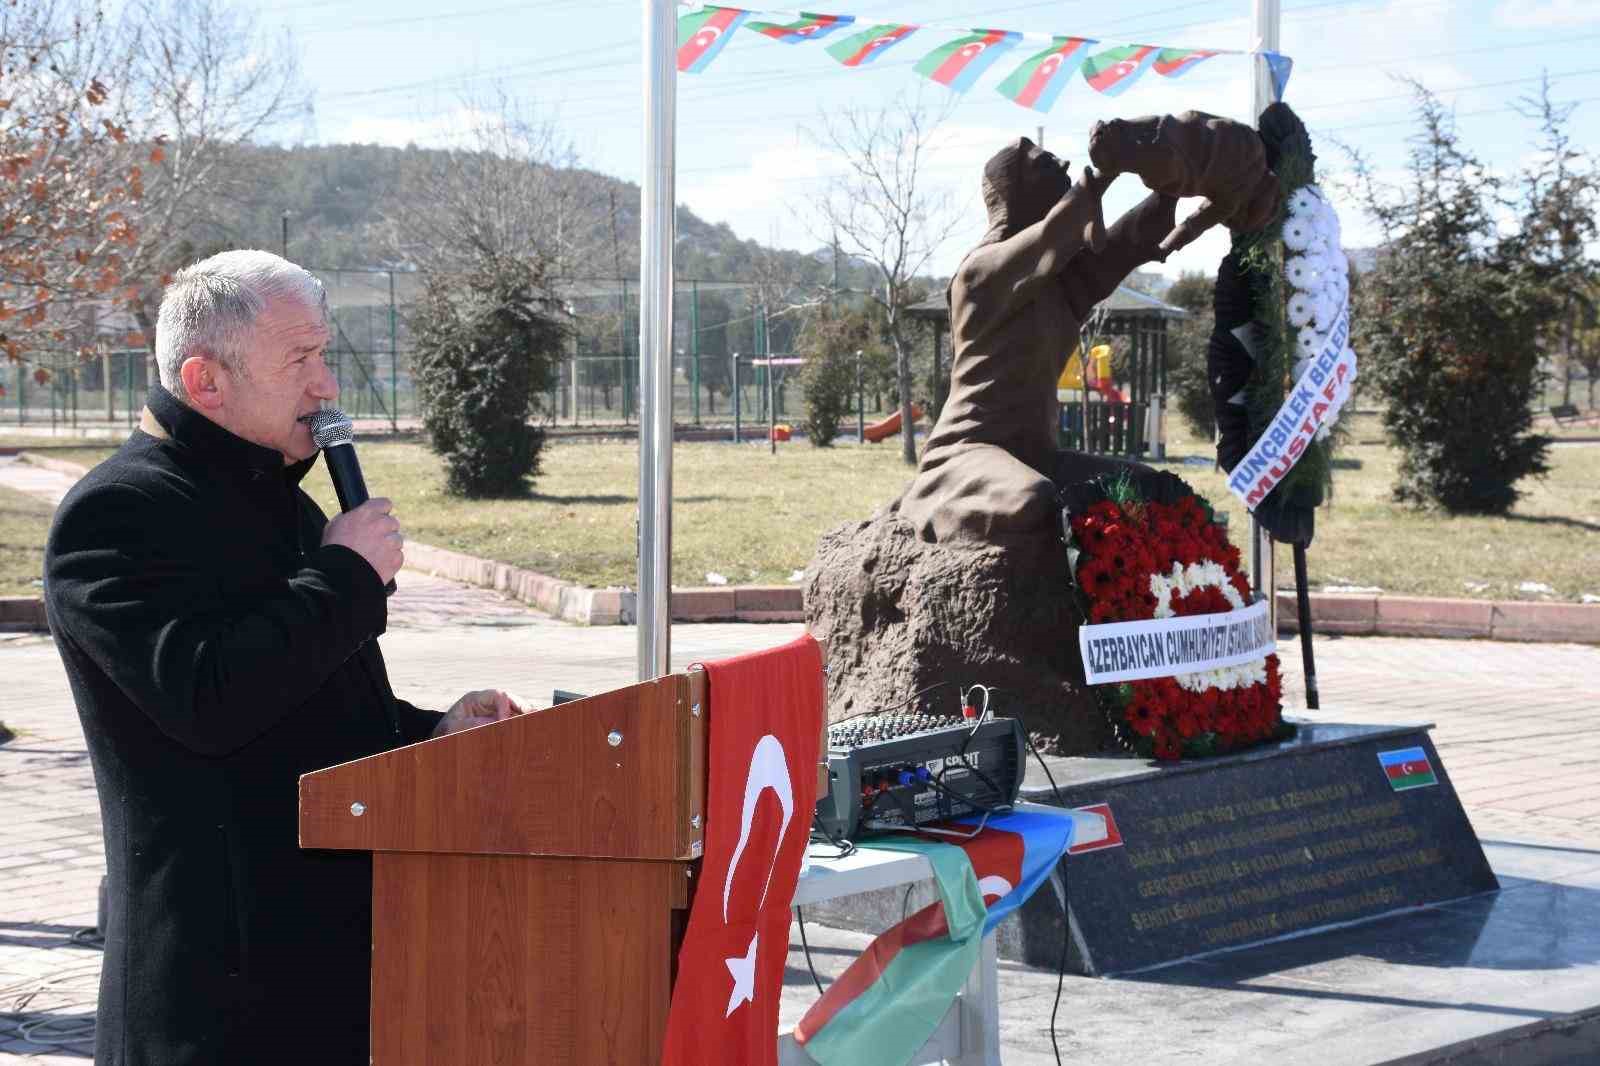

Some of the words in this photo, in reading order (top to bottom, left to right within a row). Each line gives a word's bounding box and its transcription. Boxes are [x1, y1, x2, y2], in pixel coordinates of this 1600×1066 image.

[1309, 318, 1347, 387] BELED
[1246, 362, 1347, 506] MUSTAFA
[1088, 632, 1165, 674] AZERBAYCAN
